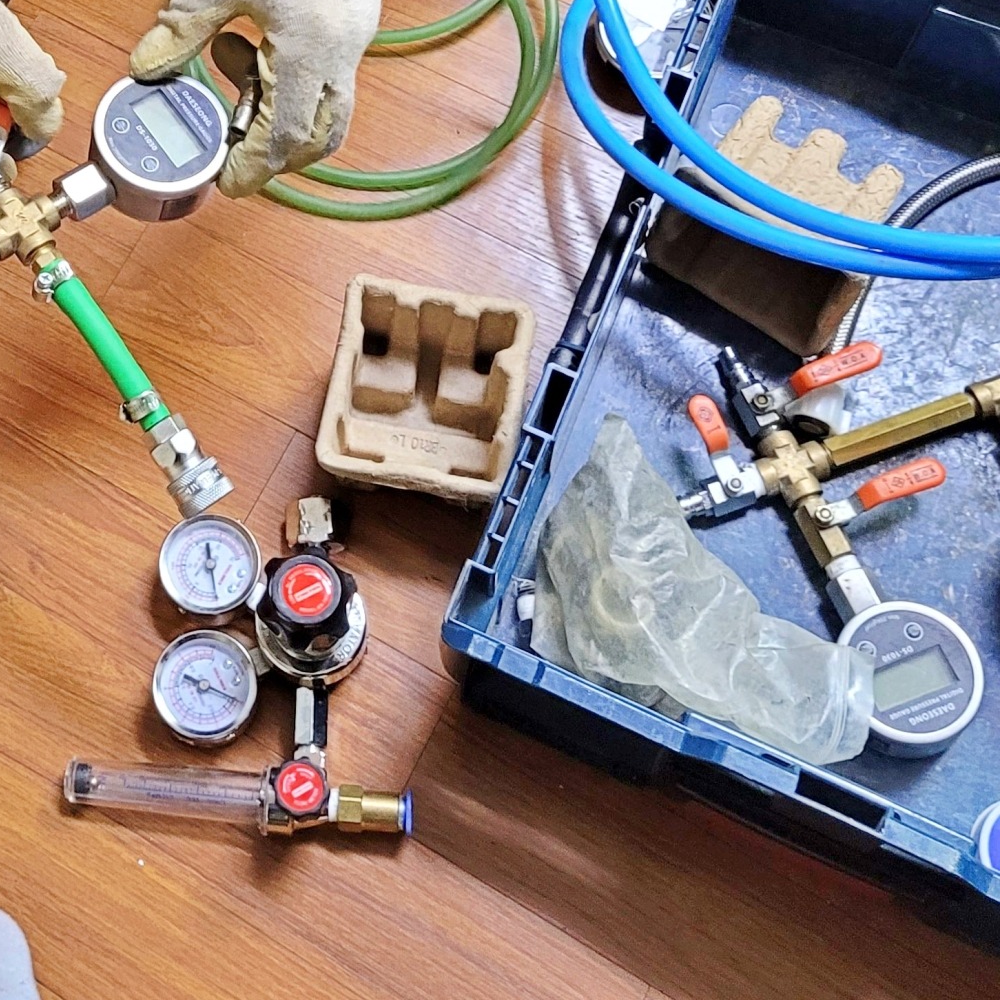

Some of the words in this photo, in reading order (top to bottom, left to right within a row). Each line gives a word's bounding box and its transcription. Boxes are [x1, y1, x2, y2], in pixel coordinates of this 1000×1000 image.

[181, 90, 213, 128] DAESEONG
[135, 124, 158, 152] DS-1030
[908, 702, 956, 726] DAESEONG
